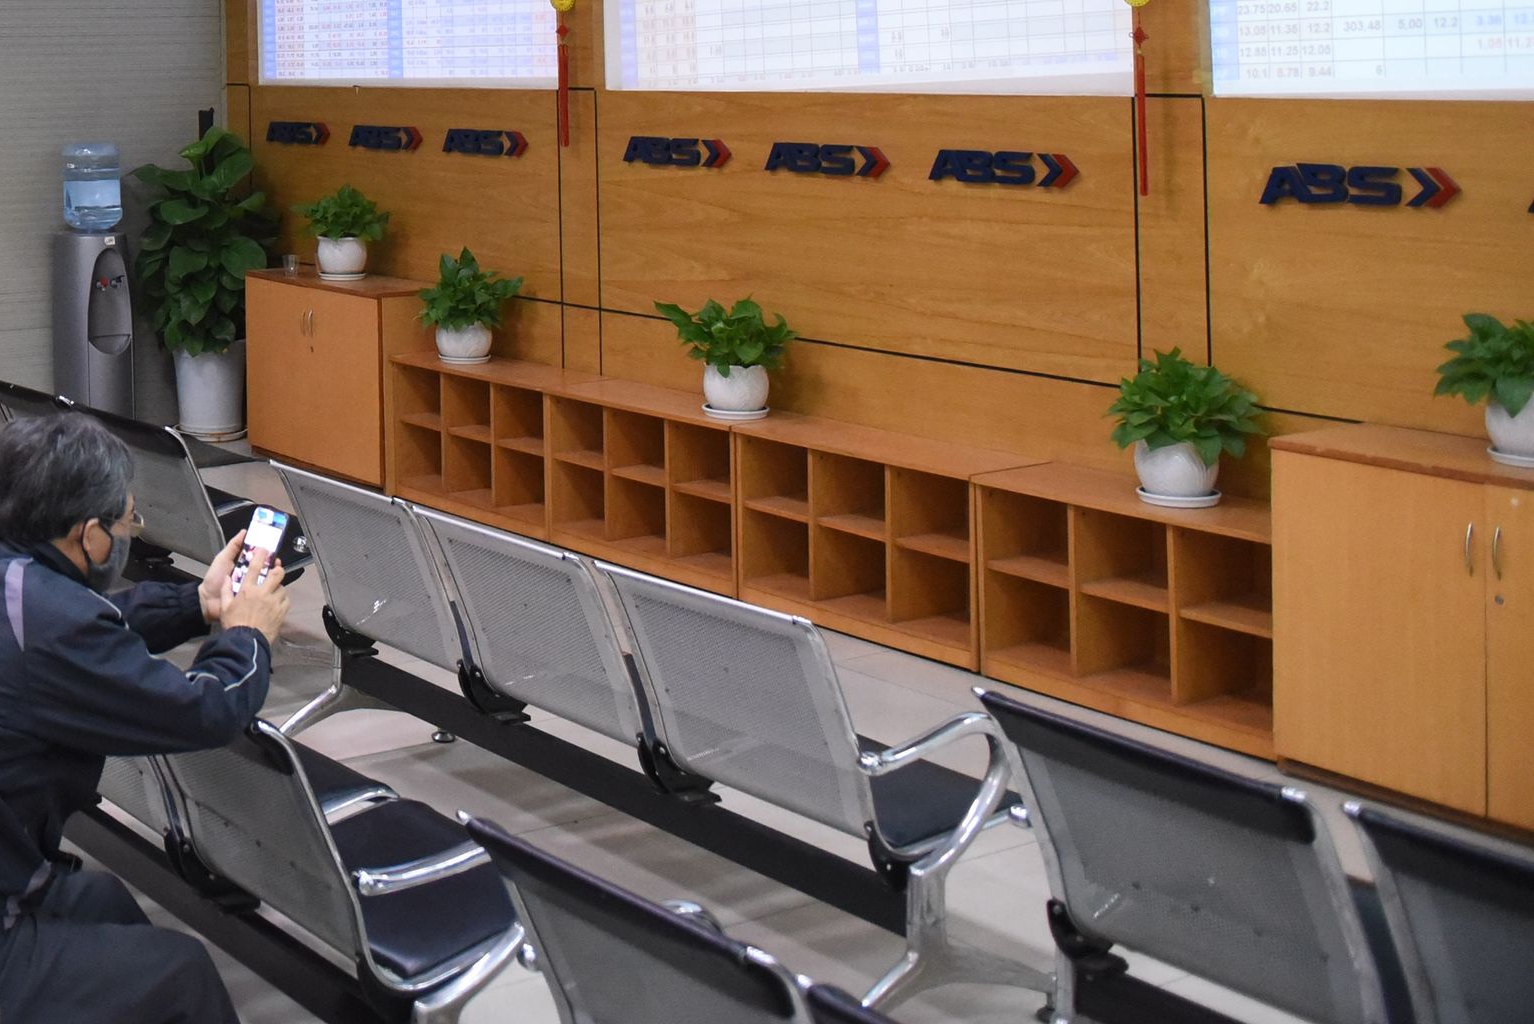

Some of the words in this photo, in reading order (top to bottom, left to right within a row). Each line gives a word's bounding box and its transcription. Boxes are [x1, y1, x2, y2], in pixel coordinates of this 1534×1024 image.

[623, 136, 701, 167] ABS
[765, 141, 855, 176] ABS
[929, 149, 1035, 186] ABS
[1258, 163, 1403, 205] ABS
